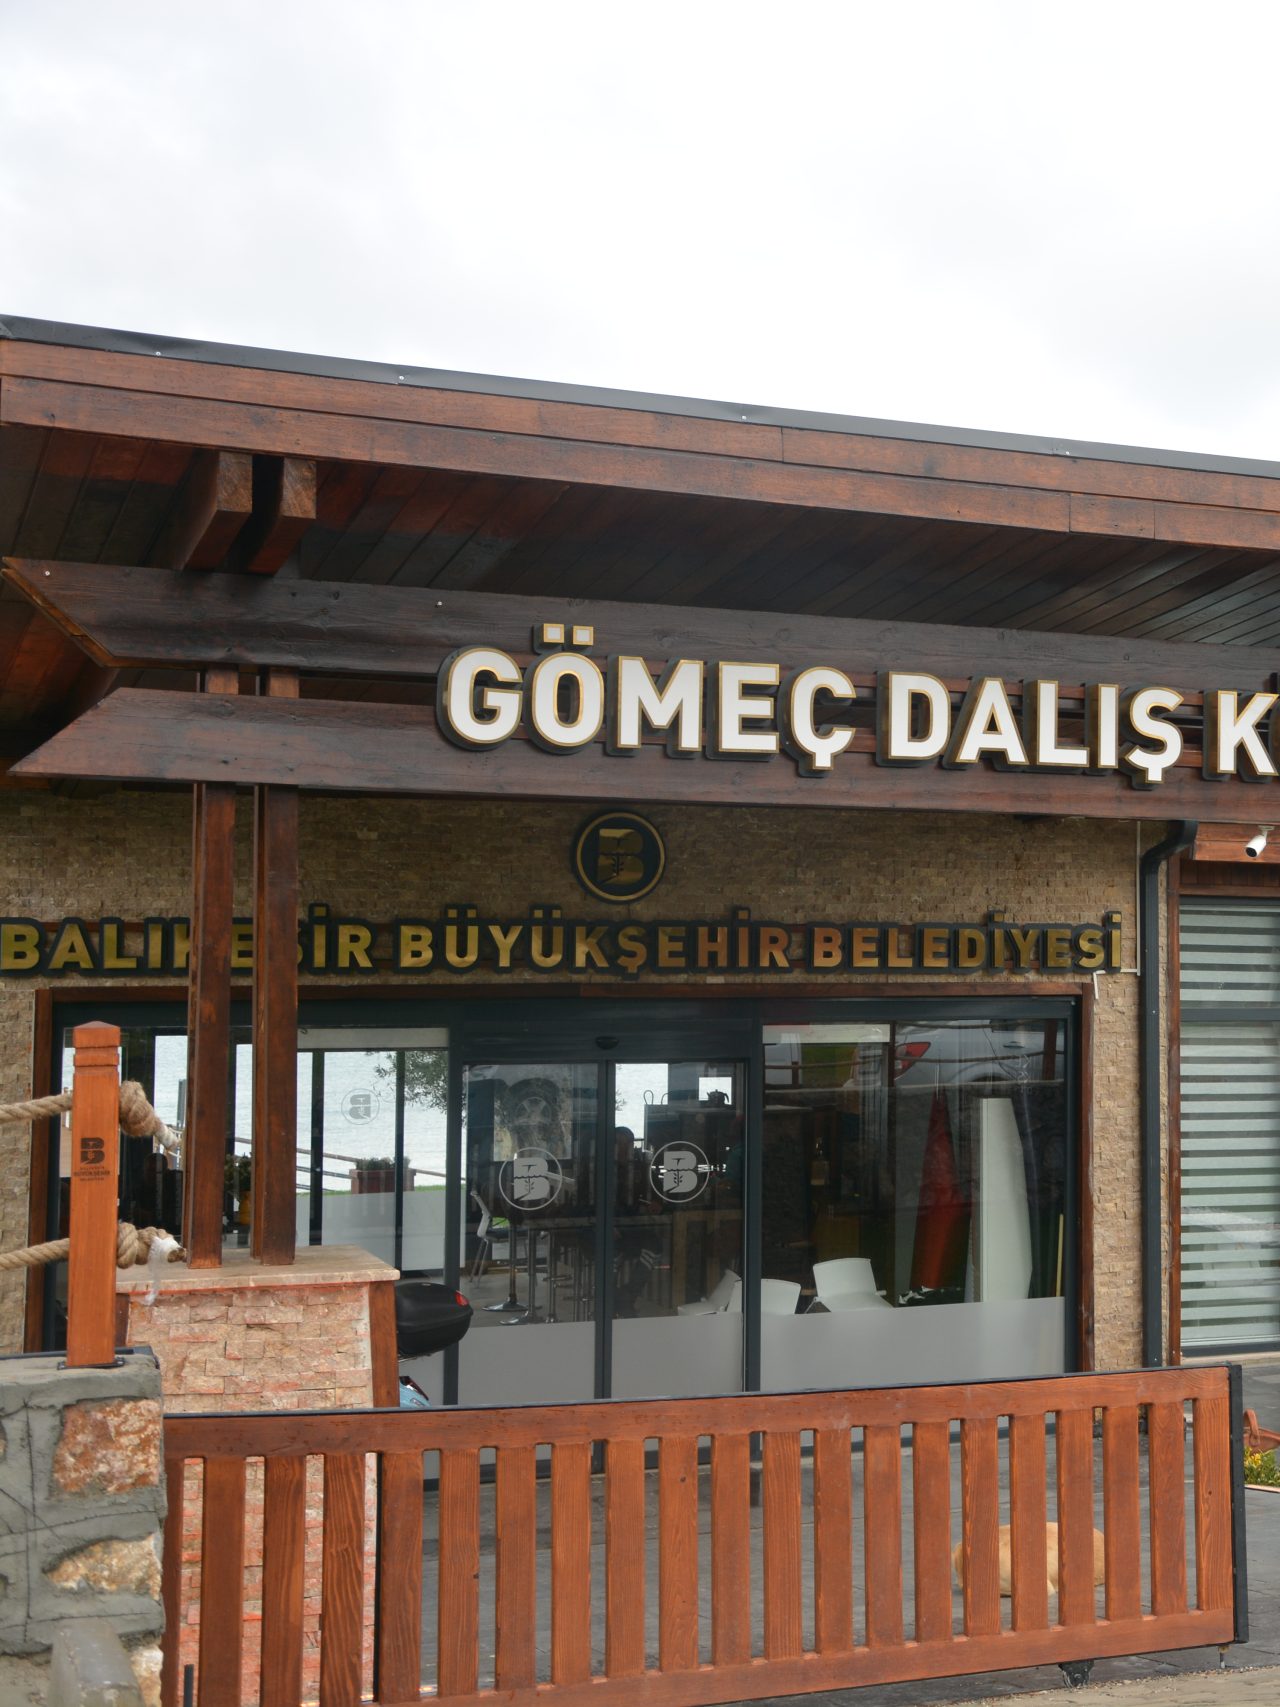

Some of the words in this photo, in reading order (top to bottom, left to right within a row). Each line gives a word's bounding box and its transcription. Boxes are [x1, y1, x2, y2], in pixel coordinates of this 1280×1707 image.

[444, 622, 857, 771] GÖMEÇ
[887, 670, 1184, 784] DALIŞ
[0, 906, 373, 970] BALIEİR
[400, 908, 790, 973] BÜYÜKŞEHİR
[813, 911, 1121, 968] BELEDİYESİ
